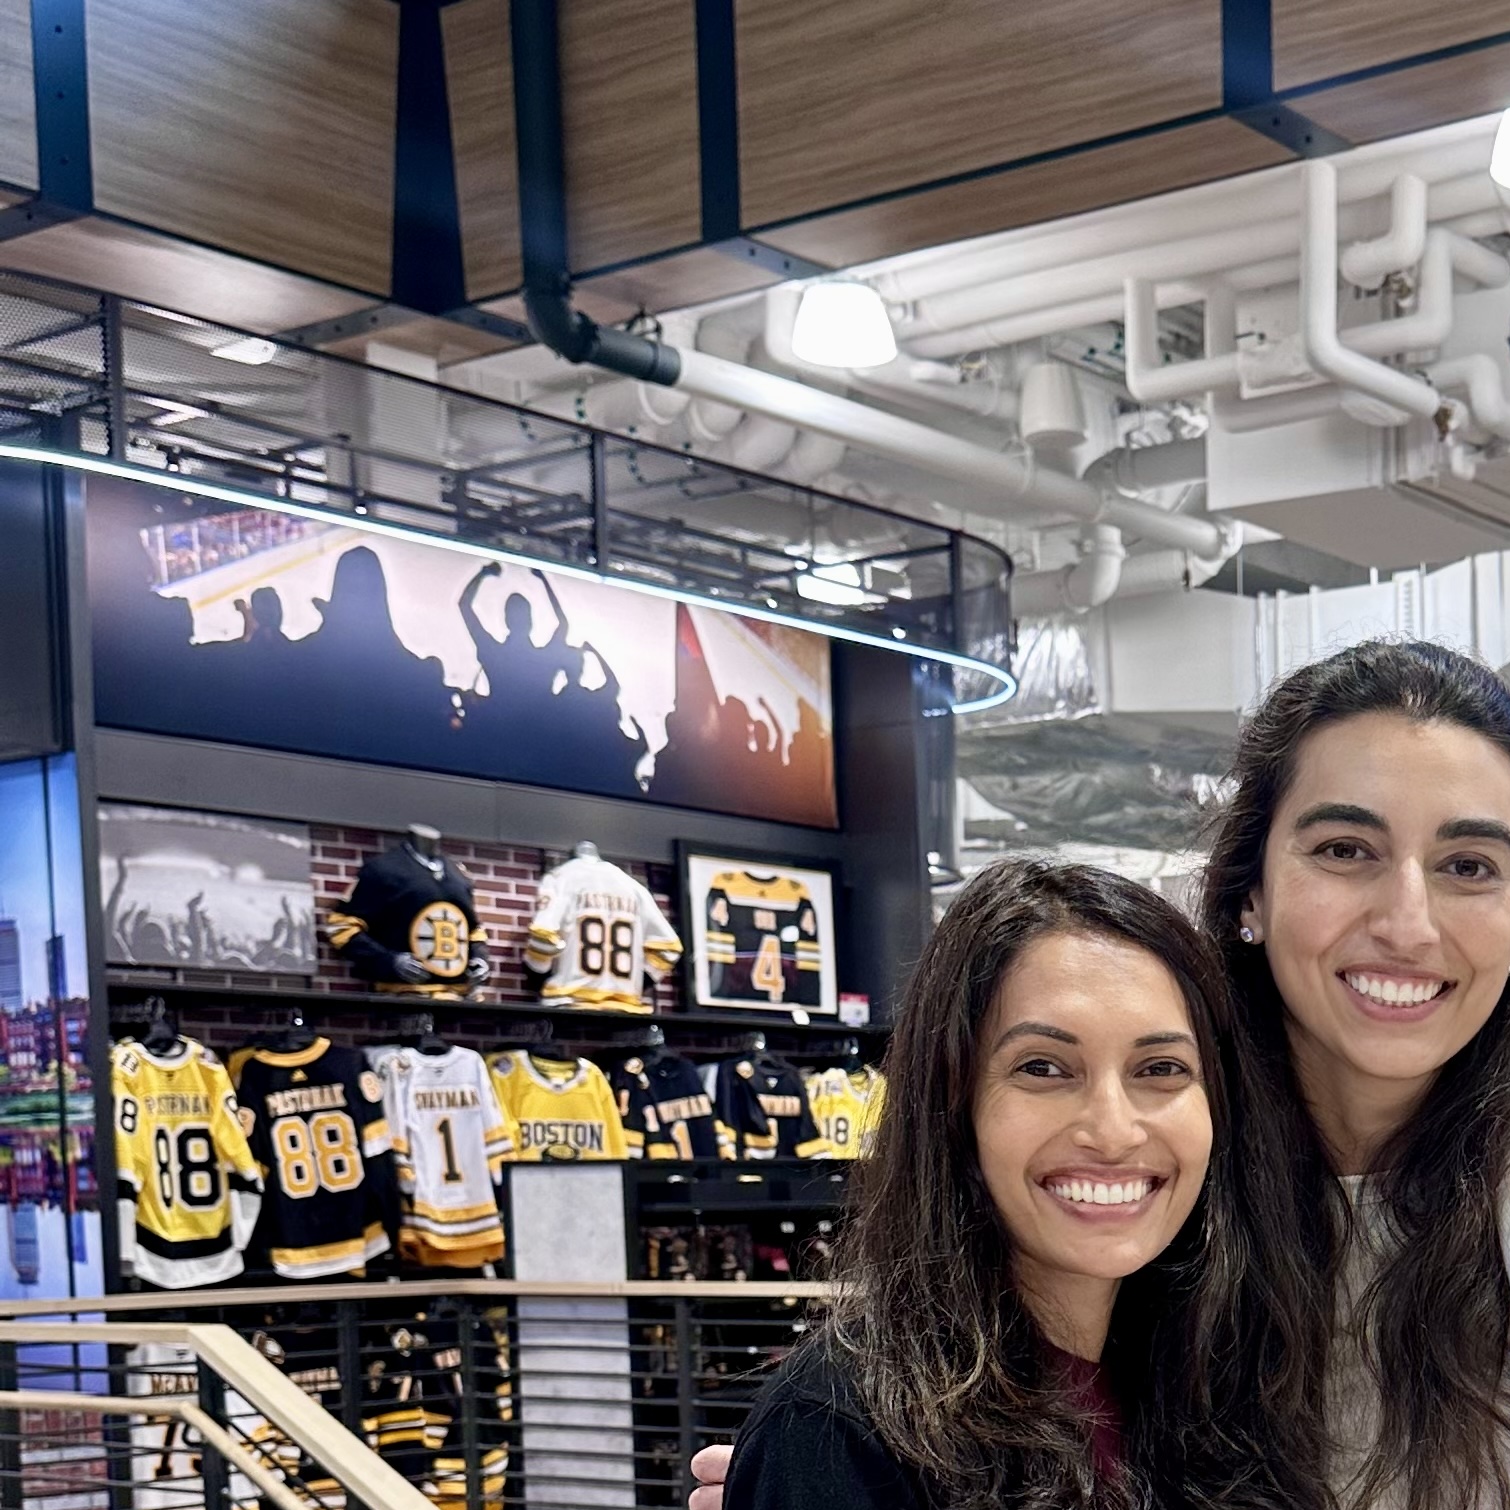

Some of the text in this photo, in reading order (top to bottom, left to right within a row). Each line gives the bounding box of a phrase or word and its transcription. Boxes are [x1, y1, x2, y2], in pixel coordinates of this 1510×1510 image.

[579, 915, 635, 980] 88
[752, 934, 786, 1004] 4
[272, 1111, 365, 1199] 88
[437, 1117, 463, 1184] 1
[519, 1121, 604, 1151] BOSTON
